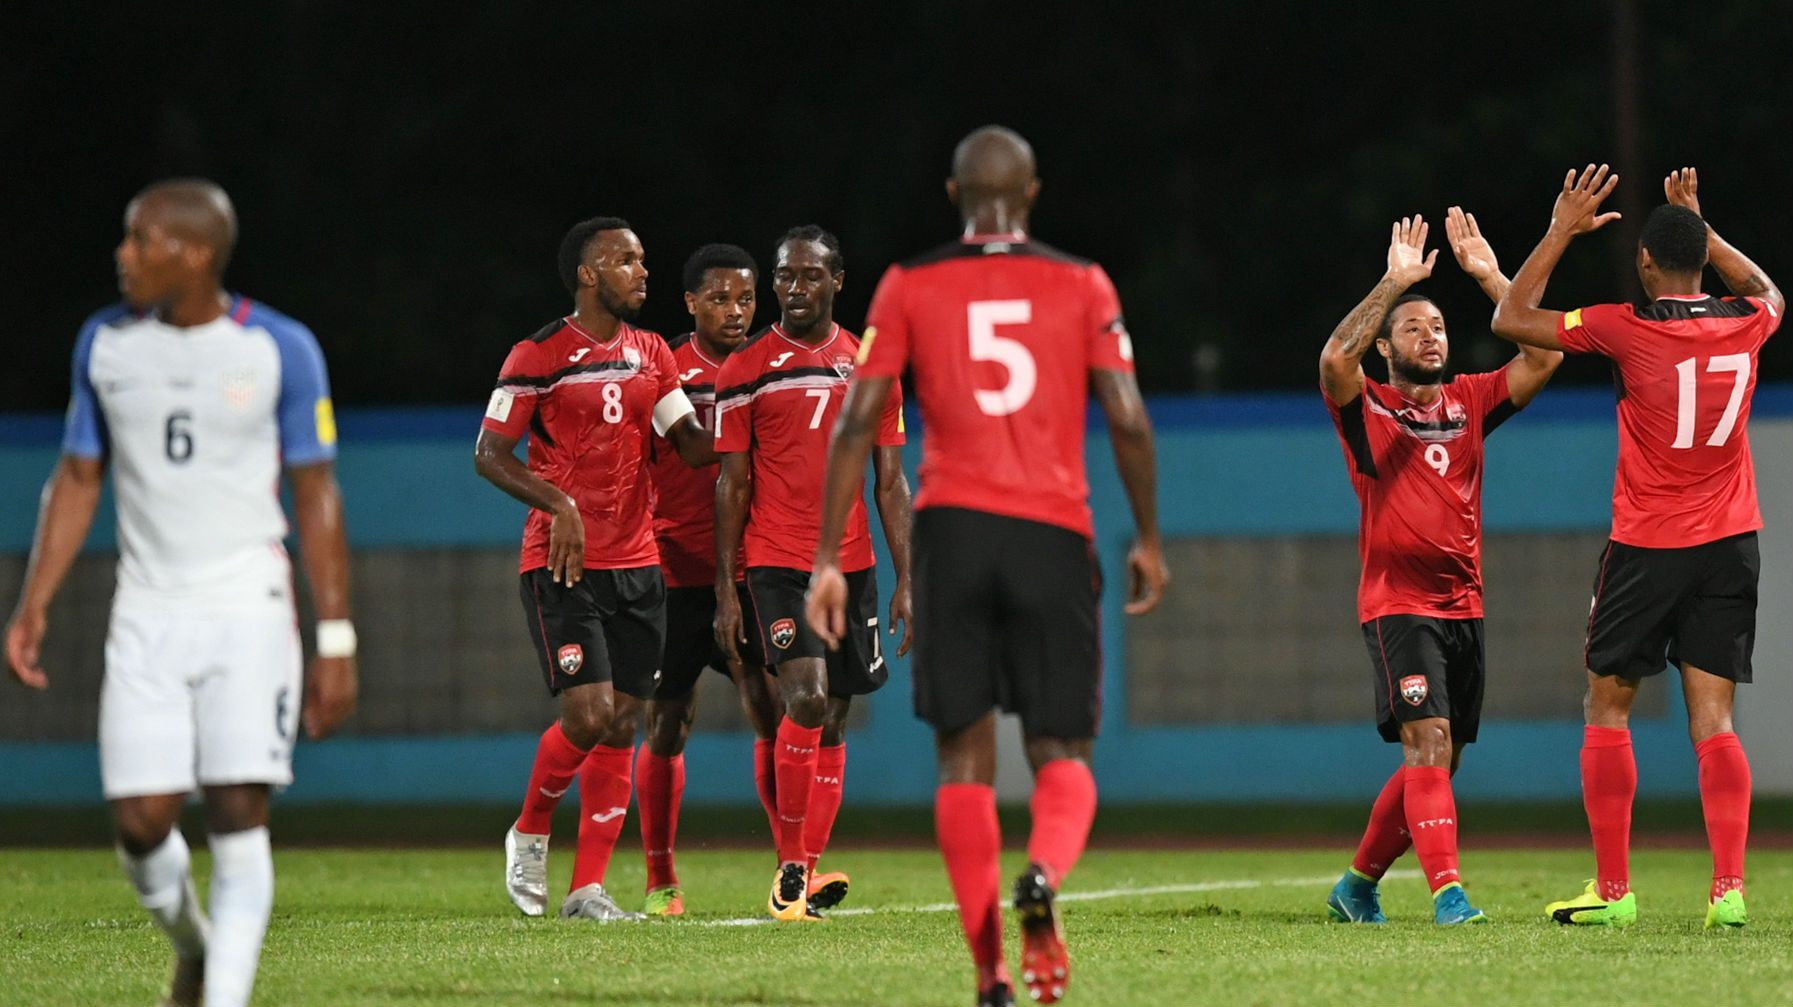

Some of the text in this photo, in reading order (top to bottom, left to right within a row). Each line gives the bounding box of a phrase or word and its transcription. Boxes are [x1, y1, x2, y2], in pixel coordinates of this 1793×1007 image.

[967, 299, 1037, 416] 5
[602, 382, 623, 424] 8
[805, 389, 830, 430] 7
[1671, 352, 1751, 449] 17
[164, 409, 194, 465] 6
[1424, 444, 1451, 477] 9
[816, 775, 838, 785] TFA
[1417, 818, 1453, 829] TTFA
